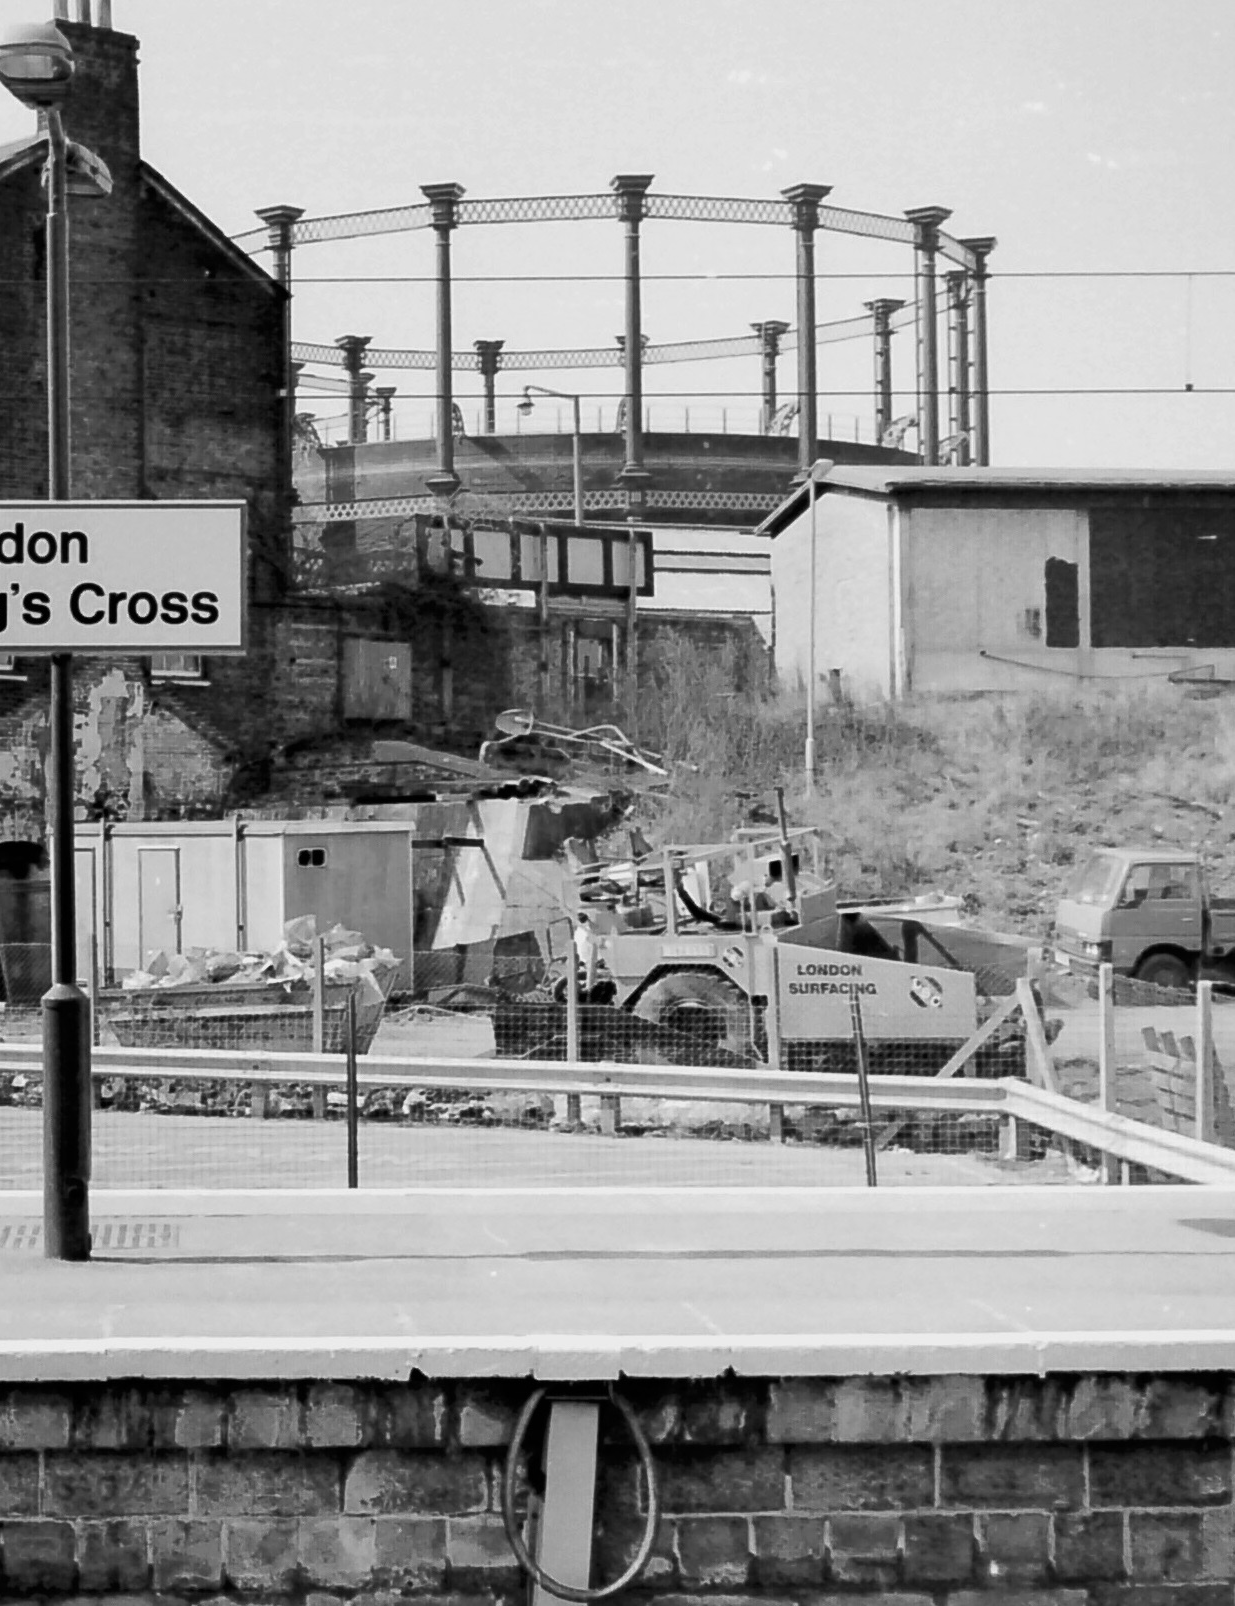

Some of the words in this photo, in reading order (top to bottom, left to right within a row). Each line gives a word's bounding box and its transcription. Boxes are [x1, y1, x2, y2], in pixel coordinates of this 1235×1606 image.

[69, 582, 219, 625] Cross
[797, 965, 862, 976] LONDON
[789, 983, 877, 995] SURFACING
